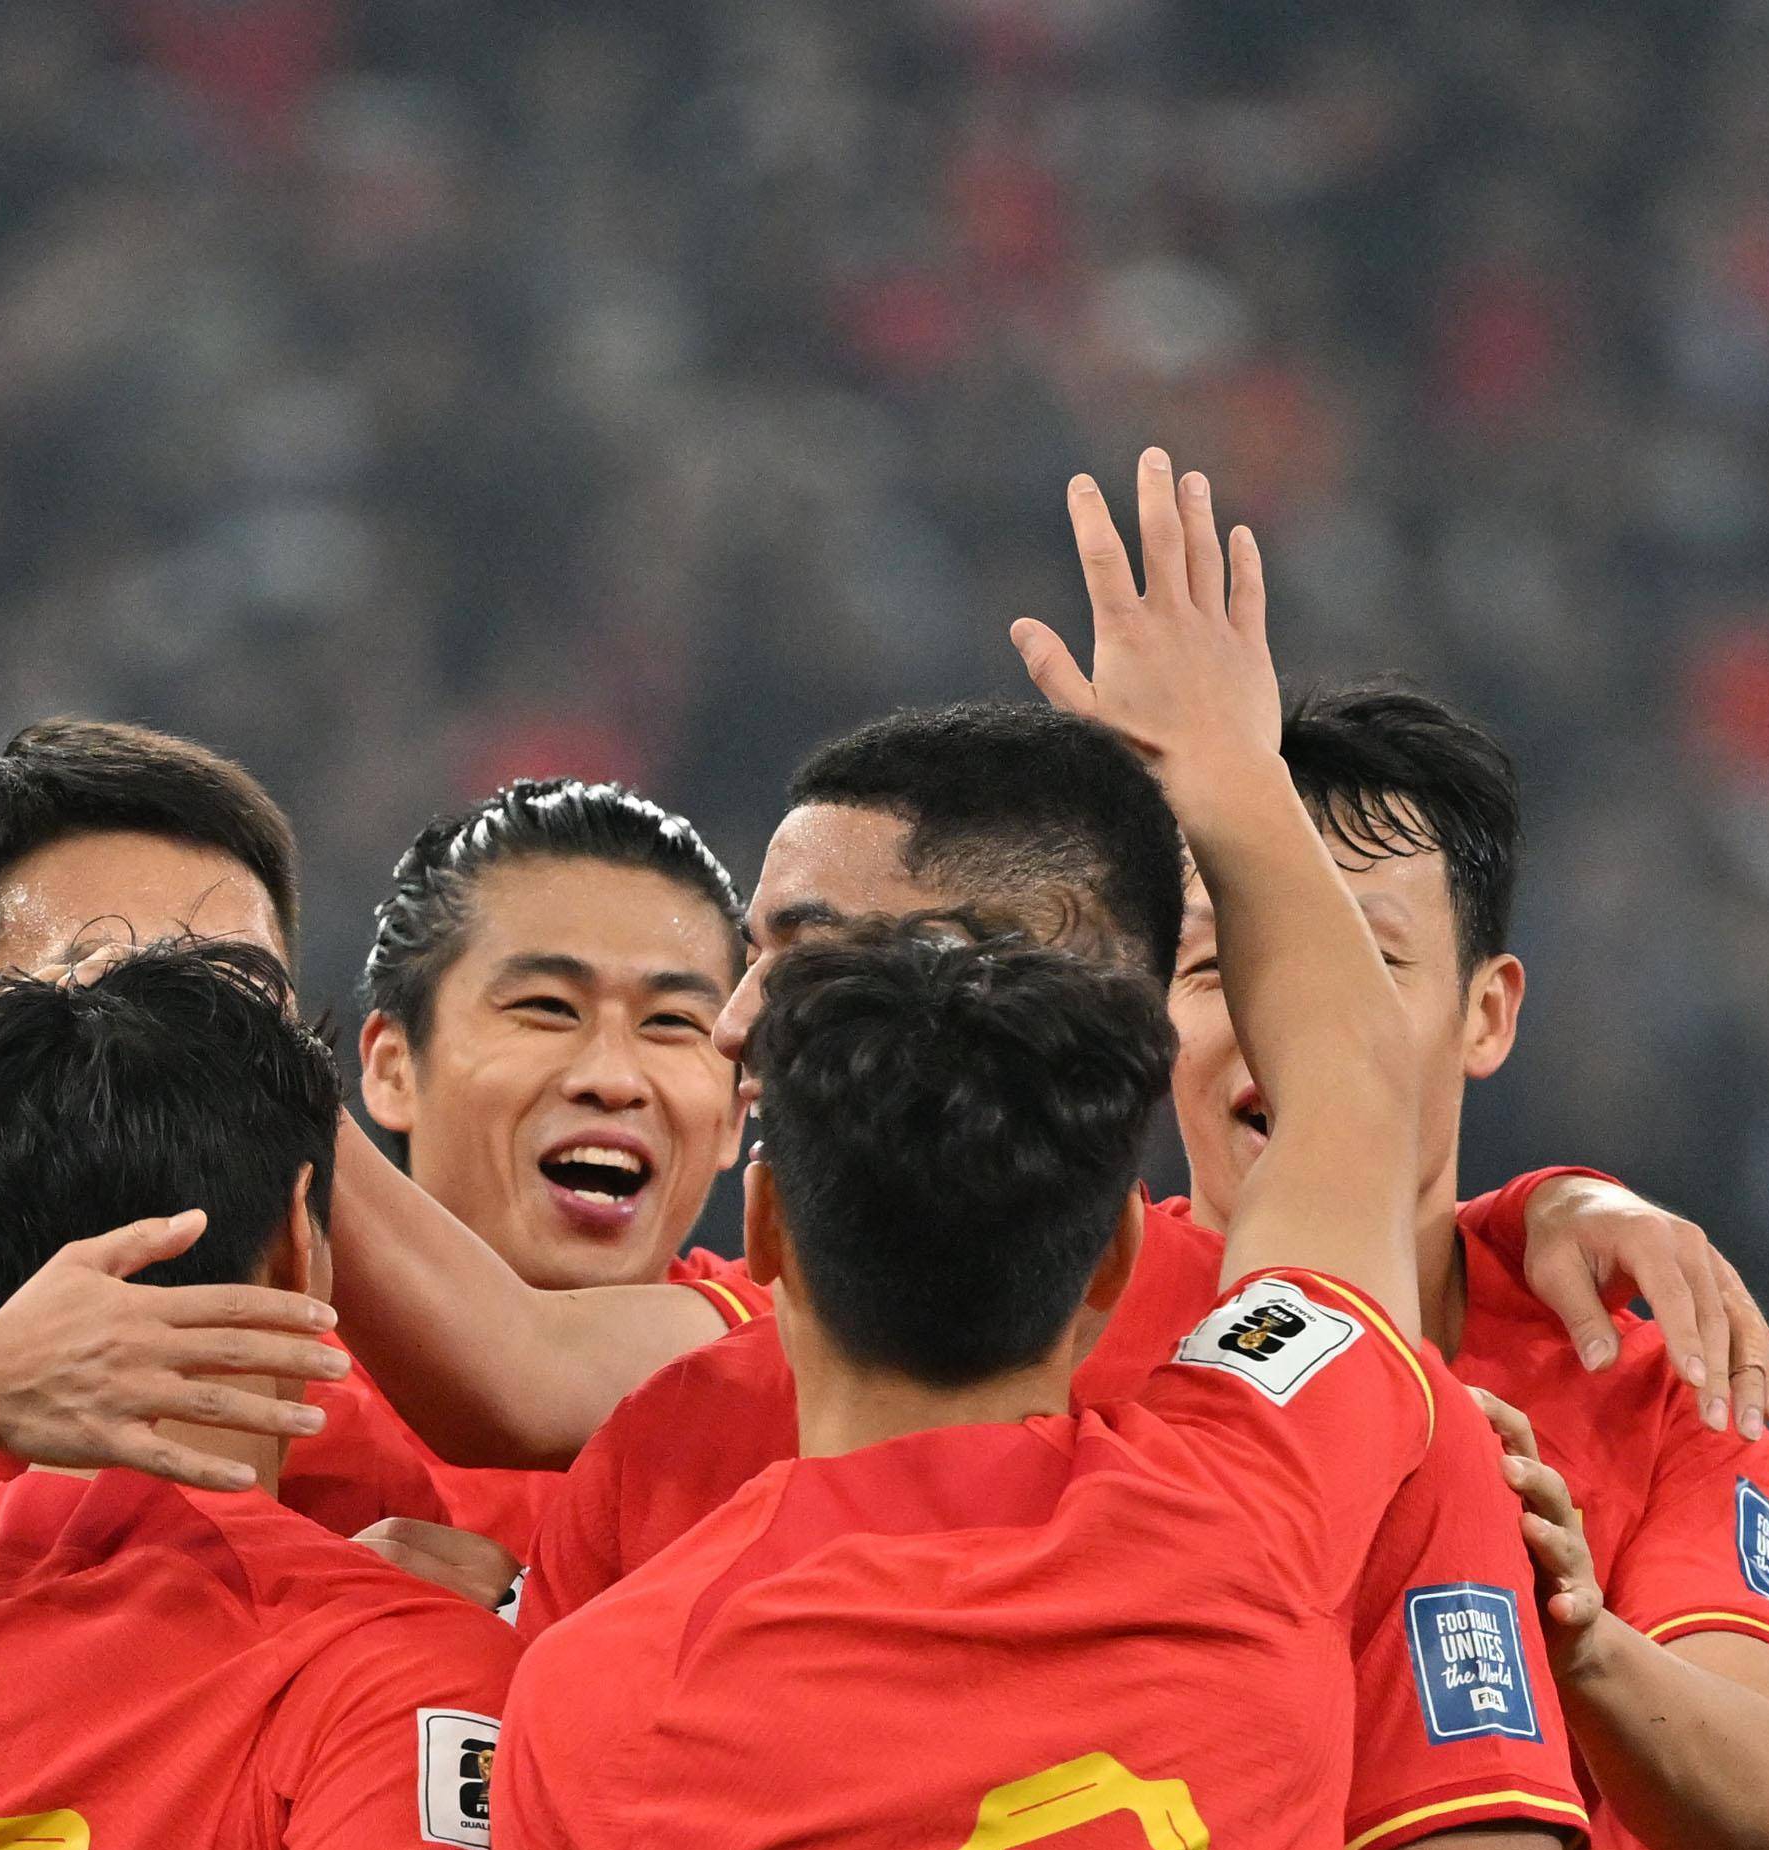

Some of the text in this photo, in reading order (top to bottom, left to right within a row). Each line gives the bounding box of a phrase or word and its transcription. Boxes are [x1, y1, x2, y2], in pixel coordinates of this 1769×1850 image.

[1436, 1609, 1501, 1635] FOOTBALL
[1441, 1630, 1506, 1664] UNITES
[1441, 1659, 1513, 1690] the World
